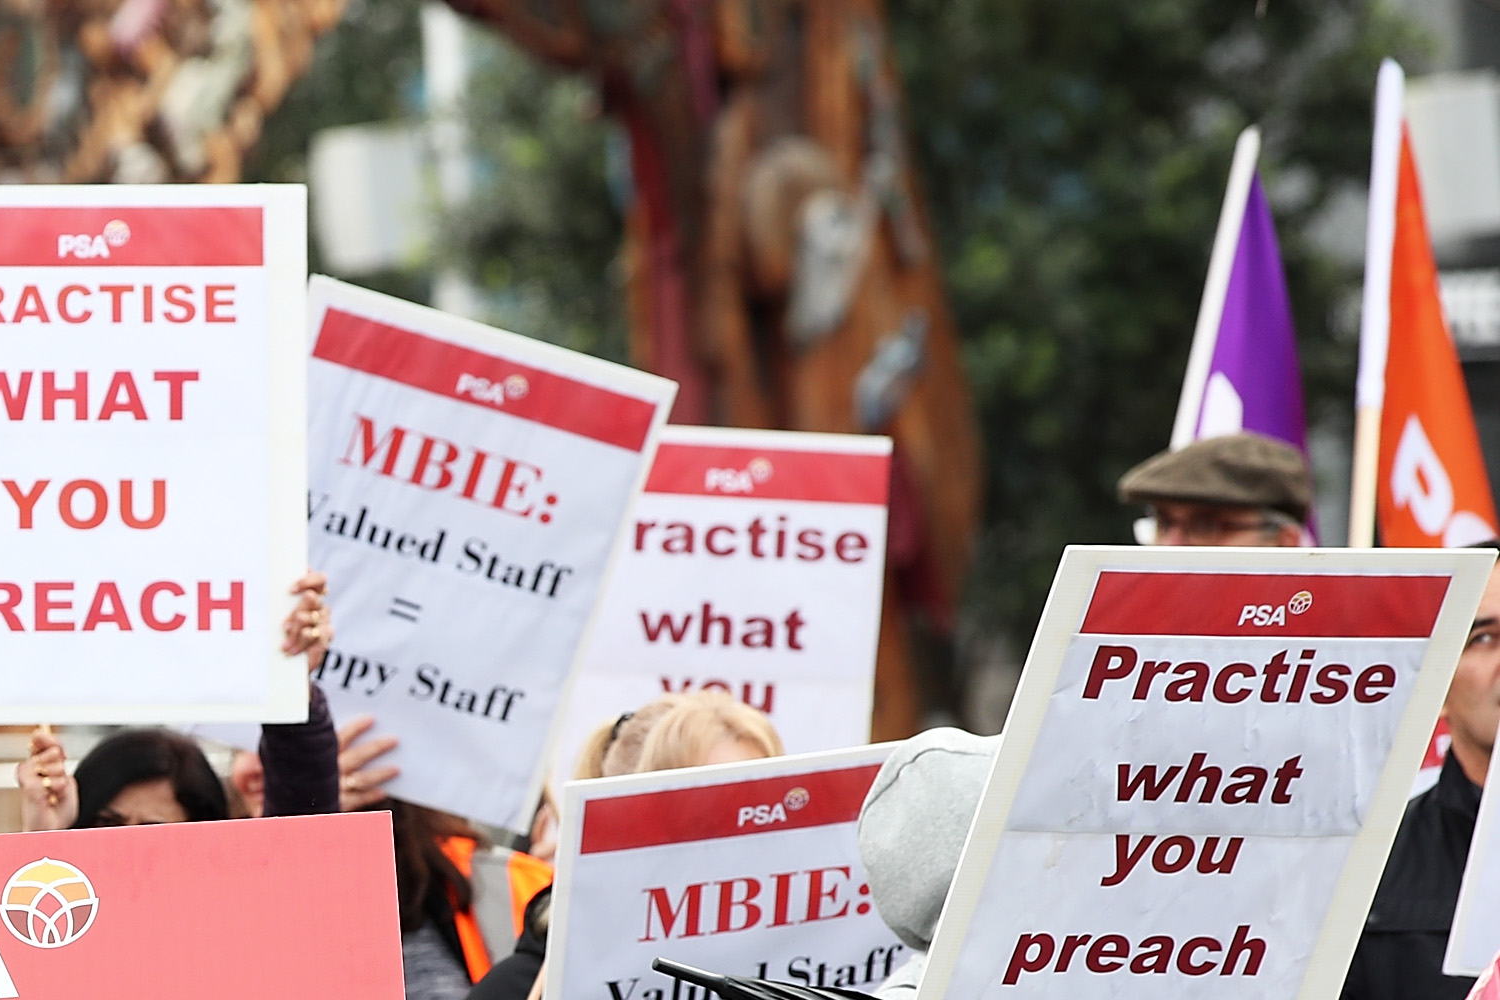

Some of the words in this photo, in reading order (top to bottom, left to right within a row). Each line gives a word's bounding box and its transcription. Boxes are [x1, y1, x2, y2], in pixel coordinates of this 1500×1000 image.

[58, 234, 110, 259] PSA
[455, 372, 505, 404] PSA
[337, 413, 560, 525] MBIE:
[704, 467, 754, 494] PSA
[1, 480, 167, 530] YOU
[634, 514, 869, 563] ractise
[456, 536, 573, 598] Staff
[639, 602, 804, 651] what
[1237, 604, 1286, 627] PSA
[316, 648, 398, 696] ppy
[409, 662, 525, 722] Staff
[1082, 645, 1397, 704] Practise
[1116, 752, 1302, 805] what
[737, 802, 787, 829] PSA
[1101, 834, 1244, 886] you
[638, 866, 871, 943] MBIE:
[1002, 925, 1267, 985] preach
